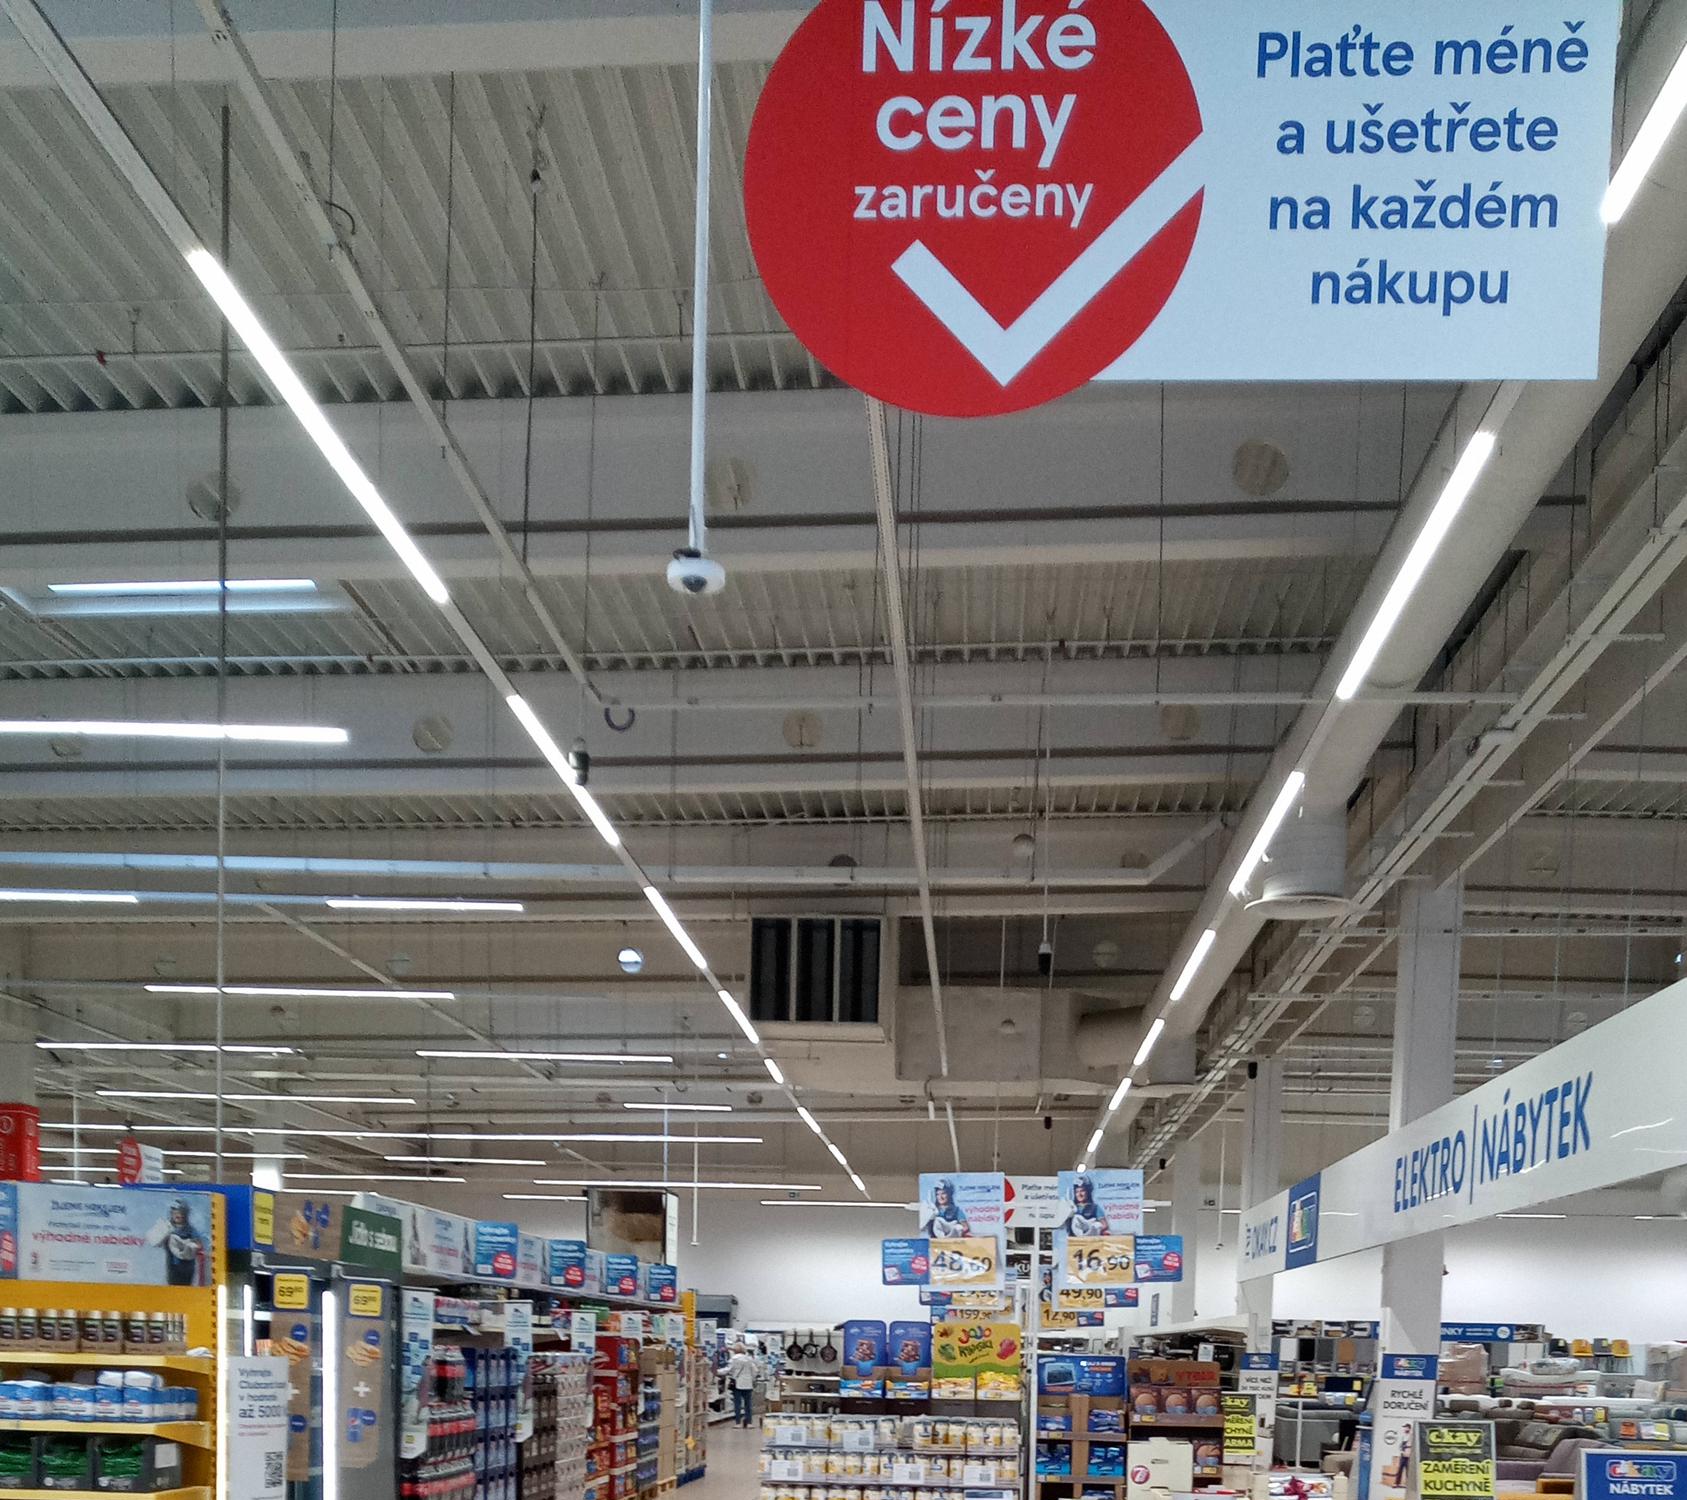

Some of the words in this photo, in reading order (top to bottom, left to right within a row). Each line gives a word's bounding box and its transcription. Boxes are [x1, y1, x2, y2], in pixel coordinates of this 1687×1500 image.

[860, 0, 1097, 74] Nízké
[1256, 25, 1414, 80] Plaťte
[1432, 22, 1590, 77] méně
[876, 93, 1077, 169] ceny
[1276, 119, 1306, 155] a
[1325, 101, 1559, 156] ušetřete
[853, 170, 1095, 228] zaručeny
[1268, 194, 1332, 232] na
[1351, 181, 1559, 231] každém
[1310, 261, 1510, 317] nákupu
[1394, 1130, 1466, 1213] ELEKTRO
[1480, 1070, 1593, 1186] NÁBYTEK
[1383, 1400, 1429, 1411] DORUČENÍ
[1423, 1478, 1491, 1492] KUCHYNĚ
[1609, 1481, 1674, 1496] NÁBYTEK
